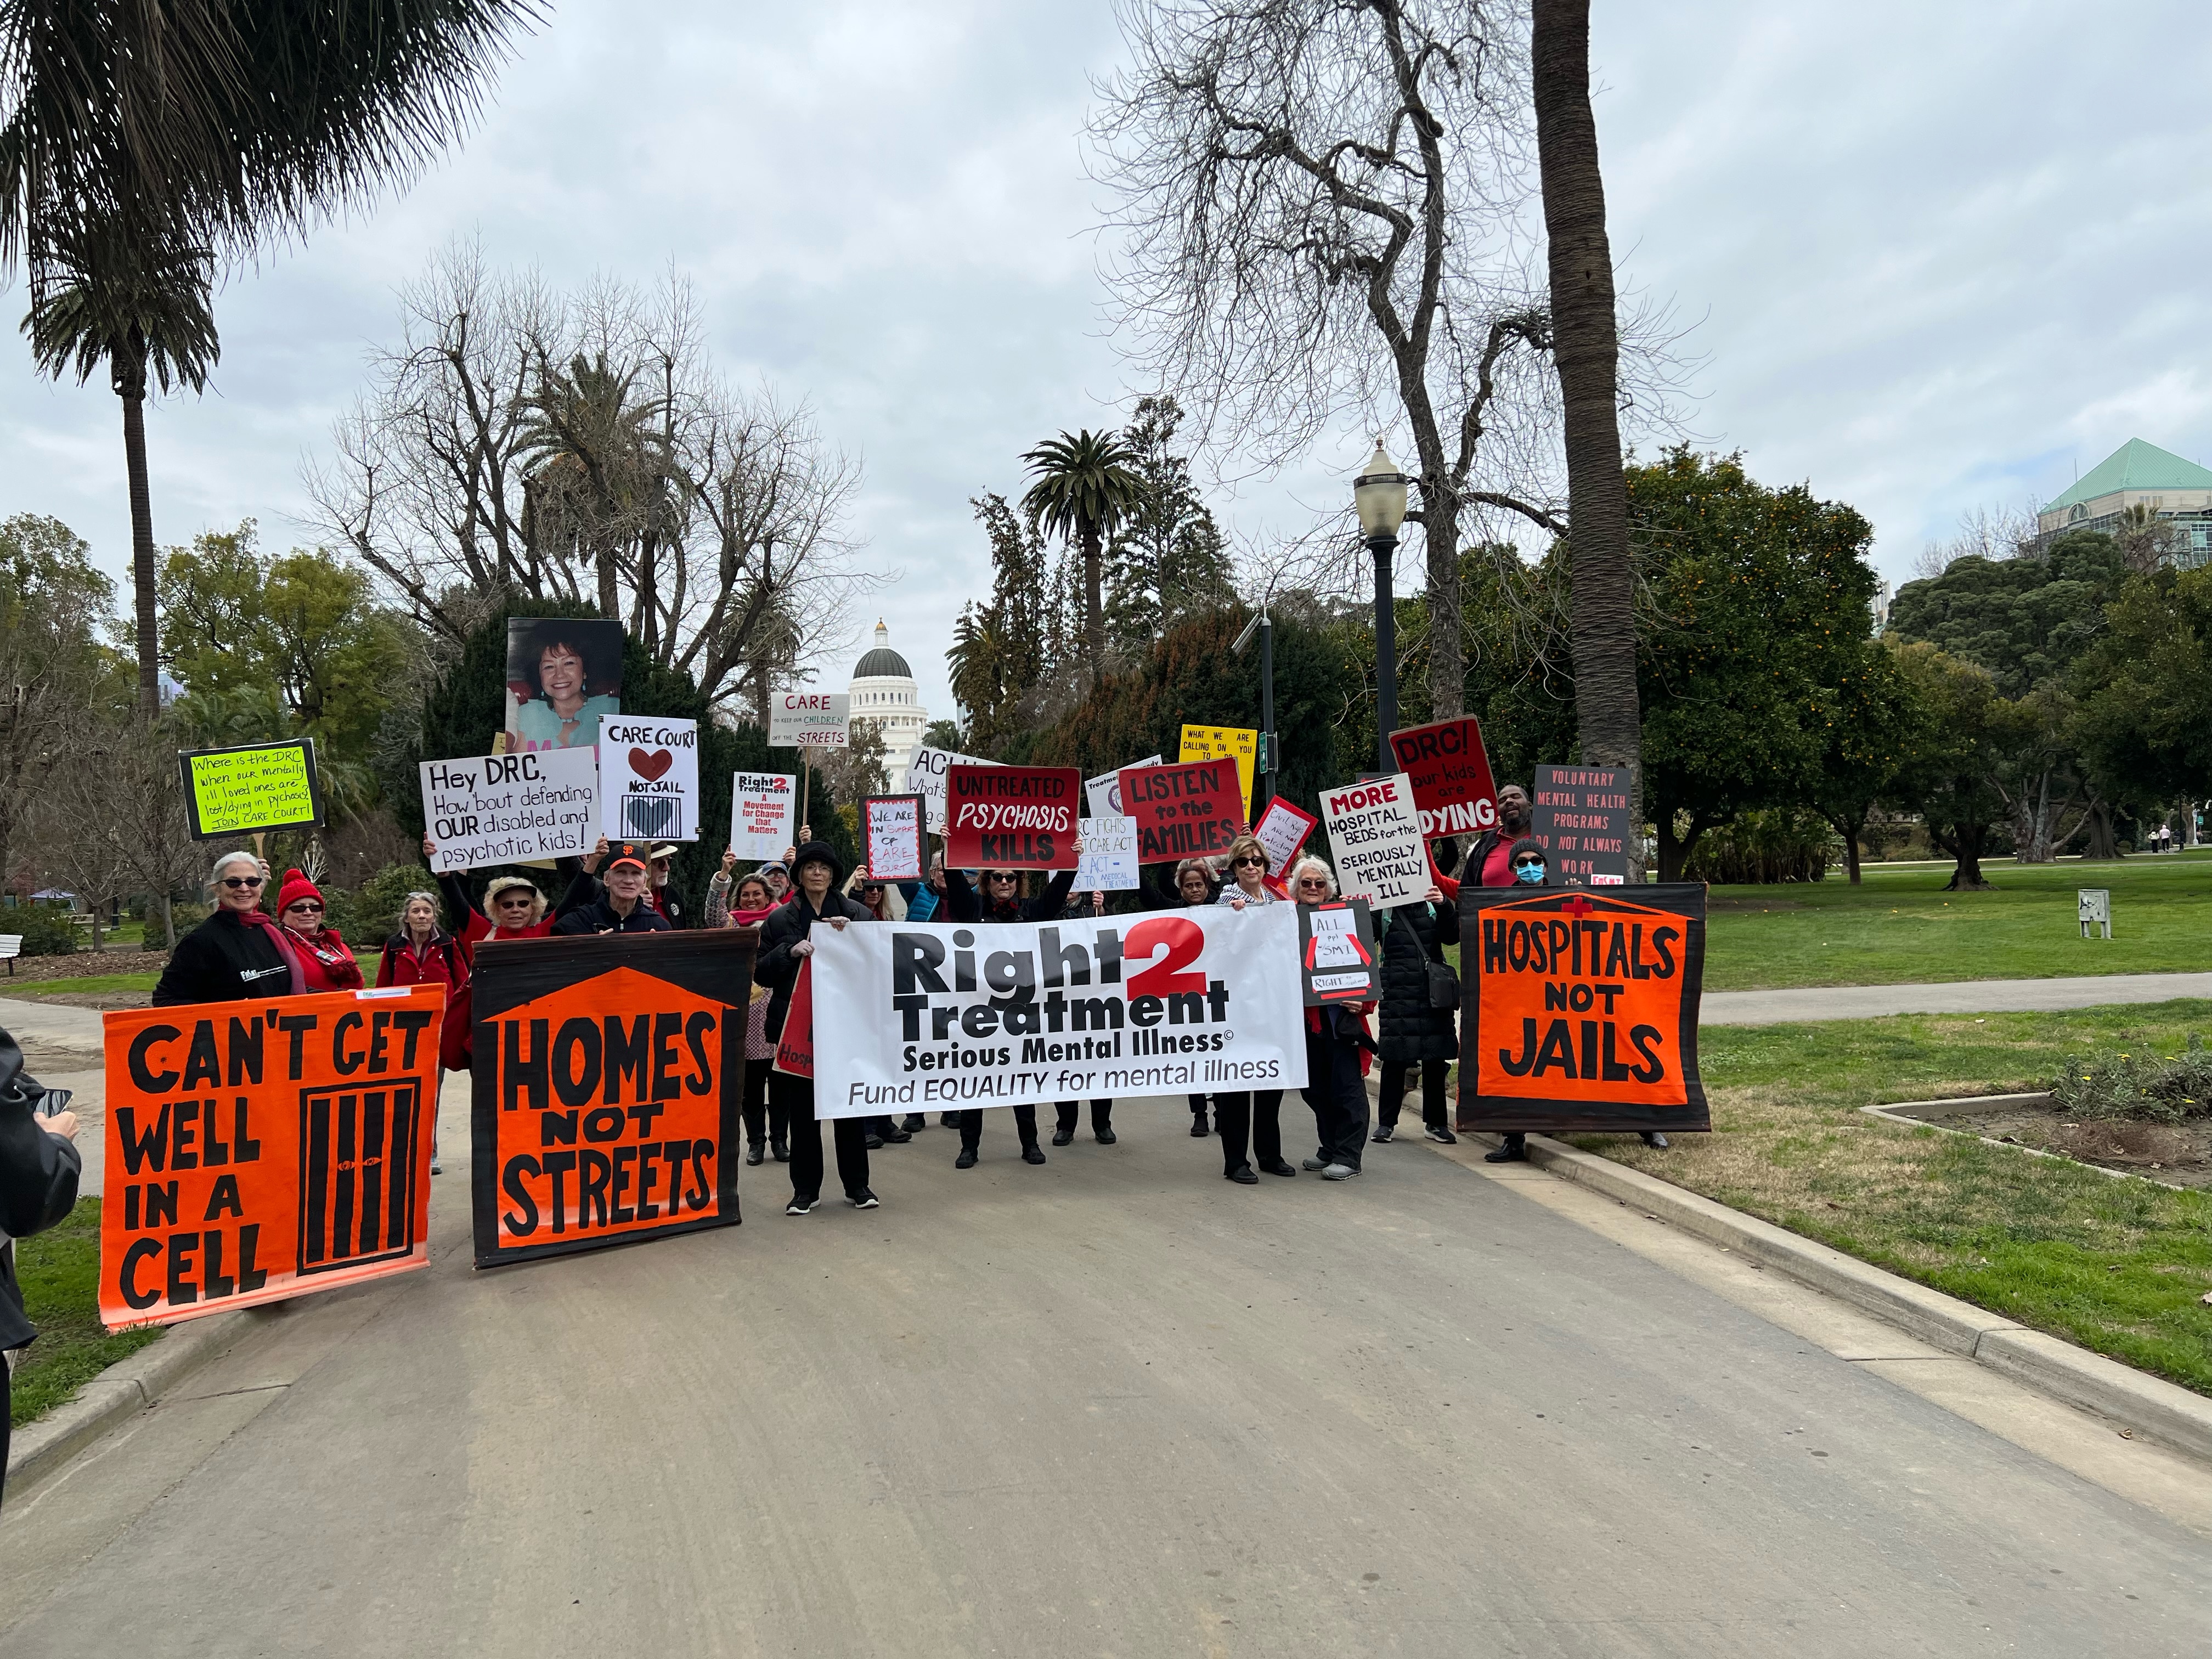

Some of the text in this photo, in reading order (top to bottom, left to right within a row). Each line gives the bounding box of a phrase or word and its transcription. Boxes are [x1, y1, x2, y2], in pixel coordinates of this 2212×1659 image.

[786, 695, 831, 710] CARE
[804, 715, 843, 724] CHILDREN
[608, 725, 696, 748] CARE COURT
[797, 732, 845, 743] STREETS
[1187, 730, 1250, 742] WHAT WE ARE
[1396, 722, 1468, 765] DRC!
[1183, 741, 1209, 751] CALLING
[1239, 746, 1252, 754] YOU
[1203, 752, 1211, 760] TO
[193, 751, 301, 771] Where is the DRC
[201, 774, 231, 787] when
[262, 763, 304, 780] mentally
[428, 754, 546, 793] Hey DRC,
[1413, 763, 1476, 788] our kids
[1552, 770, 1615, 787] VOLUNTARY
[206, 781, 298, 800] ill loved ones are
[629, 780, 685, 793] NOT JAIL
[738, 785, 790, 794] Treatment
[957, 776, 1065, 798] UNTREATED
[1130, 768, 1219, 803] LISTEN
[1438, 786, 1465, 797] are
[433, 795, 469, 815] How
[521, 785, 592, 806] defending
[744, 801, 785, 810] Movement
[1330, 782, 1398, 816] MORE
[1537, 792, 1626, 809] MENTAL HEALTH
[212, 803, 310, 829] JOIN CARE COURT!
[742, 809, 785, 819] for Change
[871, 810, 891, 822] WE
[895, 811, 915, 821] ARE
[956, 803, 1069, 832] PSYCHOSIS
[1155, 800, 1213, 820] to the
[1417, 798, 1494, 834] DYING
[435, 805, 589, 840] OUR disabled and
[748, 825, 778, 834] Matters
[755, 818, 771, 826] that
[871, 826, 883, 834] IN
[1097, 818, 1126, 836] FIGHTS
[1271, 826, 1283, 836] ARE
[1329, 807, 1407, 836] HOSPITAL
[1553, 813, 1609, 830] PROGRAMS
[881, 837, 898, 847] OF
[1259, 831, 1293, 857] Protecting
[1344, 824, 1417, 845] BEDS for the
[1536, 834, 1622, 853] DO NOT ALWAYS
[442, 823, 584, 868] psychotic kids!
[872, 847, 914, 861] CARE
[981, 833, 1055, 861] KILLS
[1090, 838, 1110, 853] CARE
[1113, 837, 1133, 851] ACT
[872, 861, 912, 873] COURT
[1090, 856, 1109, 874] ACT
[1341, 844, 1415, 870] SERIOUSLY
[1561, 859, 1594, 874] WORK
[1101, 872, 1127, 881] MEDICAL
[1357, 860, 1422, 884] MENTALLY
[1104, 879, 1137, 889] TREATMENT
[1377, 881, 1409, 900] ILL
[1317, 918, 1346, 932] ALL
[1482, 918, 1679, 980] HOSPITALS
[1314, 977, 1343, 988] RIGHT
[1545, 981, 1624, 1015] NOT
[893, 980, 1229, 1041] Treatment
[128, 1009, 433, 1094] CAN'T GET
[503, 1011, 716, 1111] HOMES
[904, 1042, 1011, 1071] Serious
[1022, 1032, 1121, 1064] Mental
[1499, 1018, 1664, 1085] JAILS
[849, 1059, 1279, 1106] Fund EQUALITY for mental illness
[541, 1103, 664, 1146] NOT
[115, 1097, 261, 1176] WELL
[503, 1139, 715, 1237] STREETS
[125, 1175, 244, 1231] IN A
[119, 1223, 268, 1310] CELL
